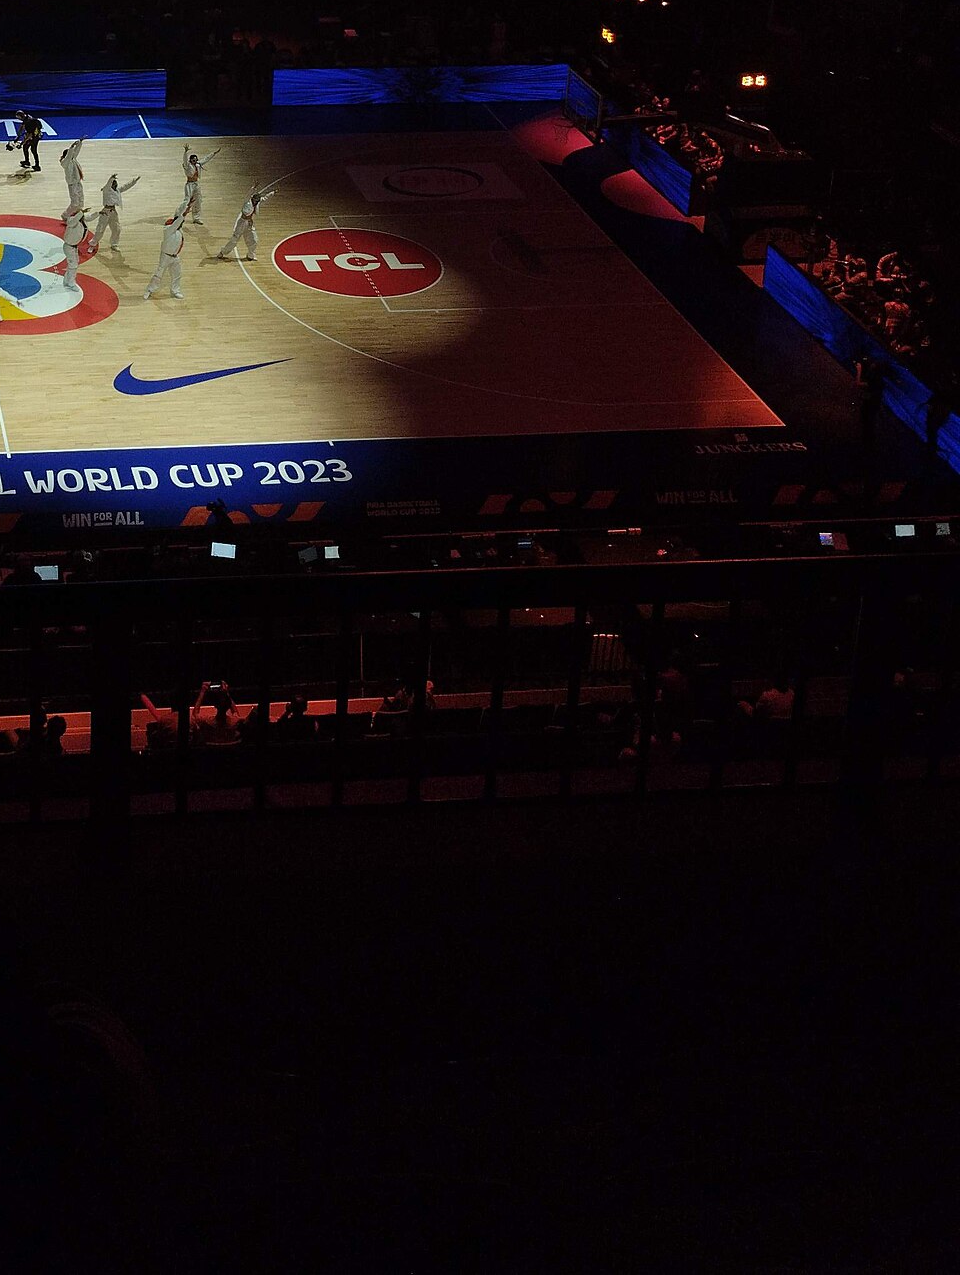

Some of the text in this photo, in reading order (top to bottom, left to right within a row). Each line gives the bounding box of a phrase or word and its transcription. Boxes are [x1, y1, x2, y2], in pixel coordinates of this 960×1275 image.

[284, 252, 426, 272] TCL
[24, 467, 159, 494] WORLD
[169, 461, 244, 488] CUP
[253, 459, 353, 485] 2023
[62, 511, 145, 528] WIN FOR ALL
